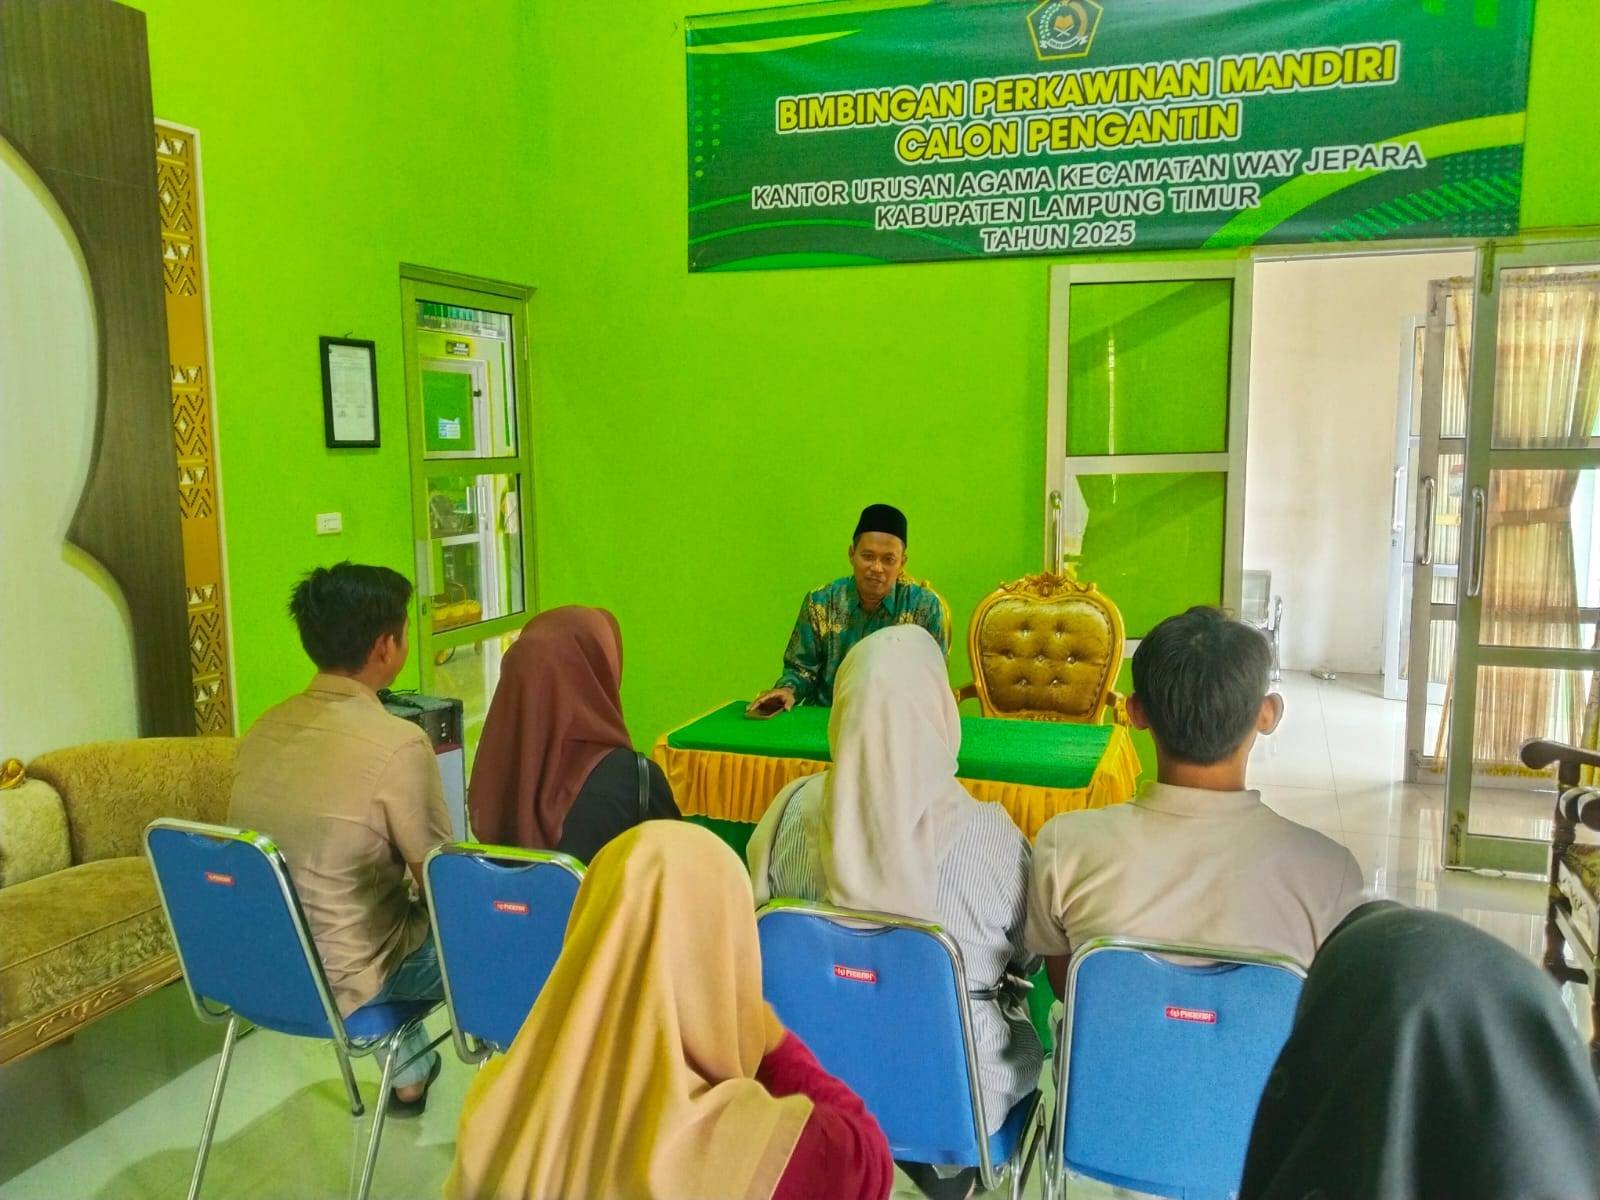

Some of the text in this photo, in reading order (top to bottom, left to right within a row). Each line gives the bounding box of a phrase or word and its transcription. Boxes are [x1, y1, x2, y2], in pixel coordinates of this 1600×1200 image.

[777, 43, 1398, 133] BIMBINGAN PERKAWINAN MANDIRI
[897, 103, 1240, 163] CALON PENGANTIN
[752, 142, 1424, 209] KANTOR URUSAN AGAMA KECAMATAN WAY JEPARA
[876, 184, 1260, 229] KABUPATEN LAMPUNG TIMUR
[982, 221, 1136, 252] TAHUN 2025
